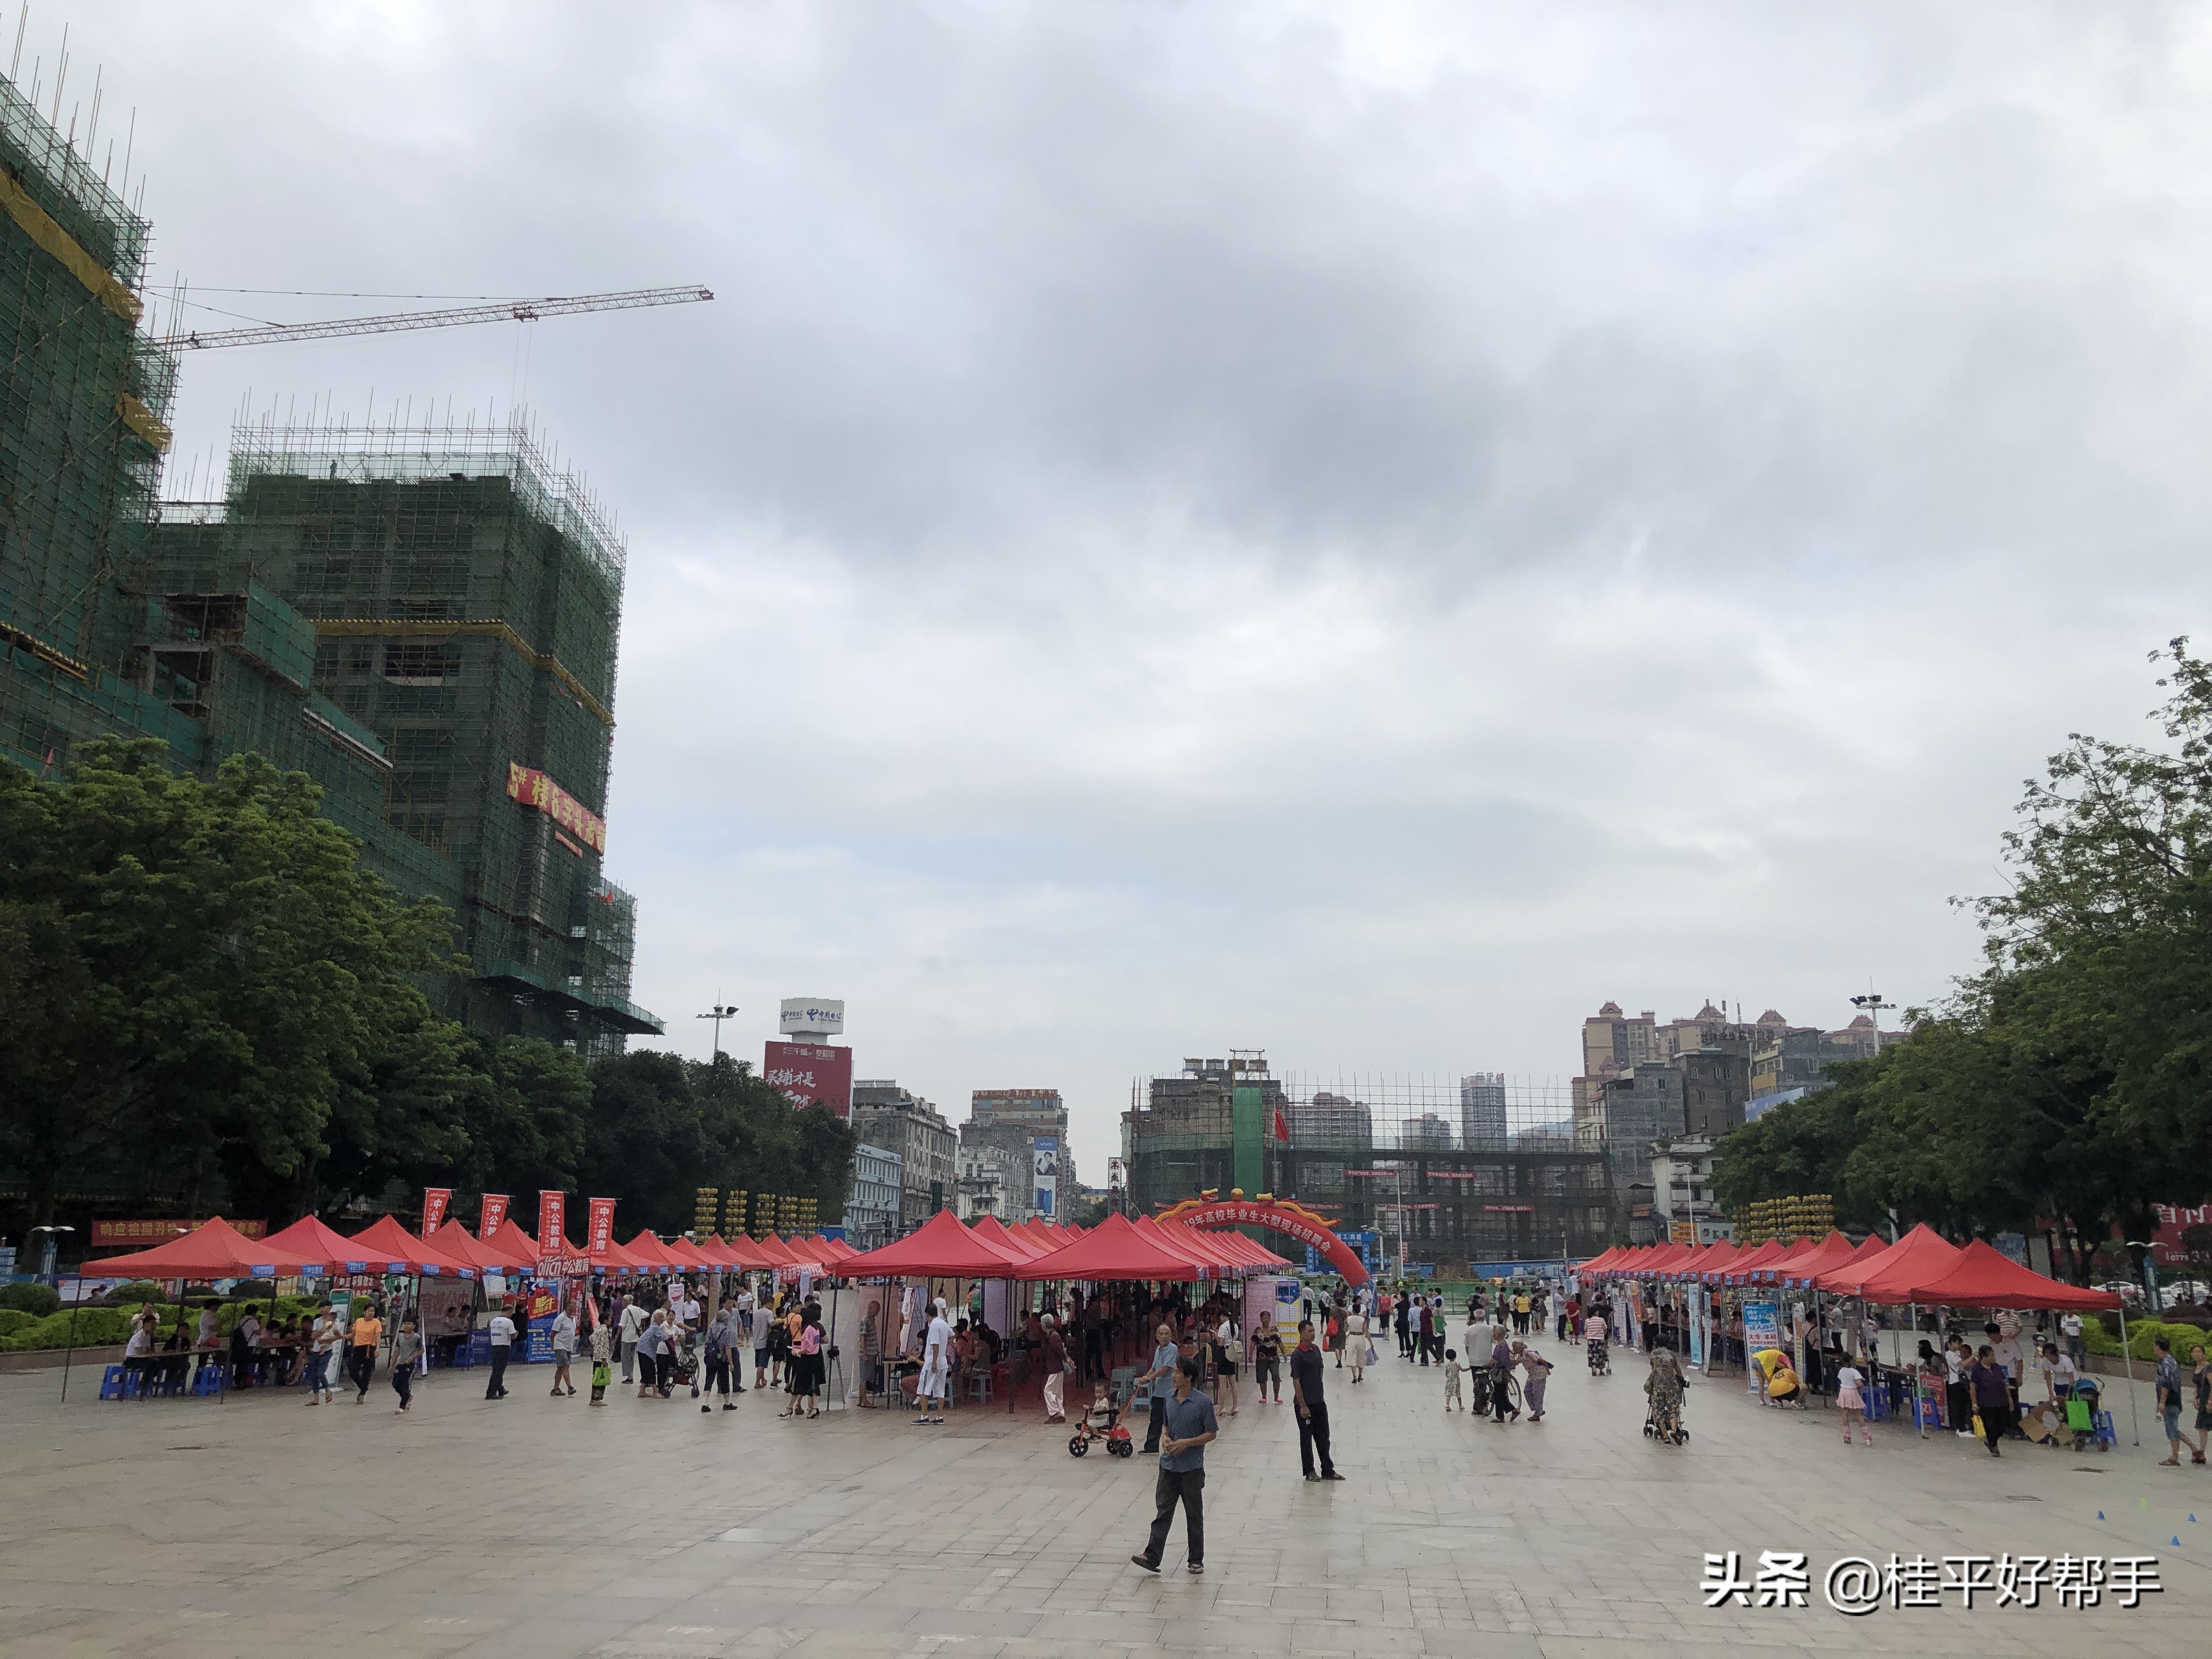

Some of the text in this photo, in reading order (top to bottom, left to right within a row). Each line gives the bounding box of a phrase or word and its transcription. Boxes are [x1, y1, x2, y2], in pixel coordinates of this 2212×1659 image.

[819, 1010, 842, 1019] 中国电信
[766, 1067, 816, 1088] 买铺才是
[550, 1201, 560, 1248] 中公教育
[596, 1206, 610, 1250] 中公教育
[1183, 1208, 1331, 1252] 19年高校毕业生大型现场招聘会
[562, 1257, 590, 1275] 中公教育
